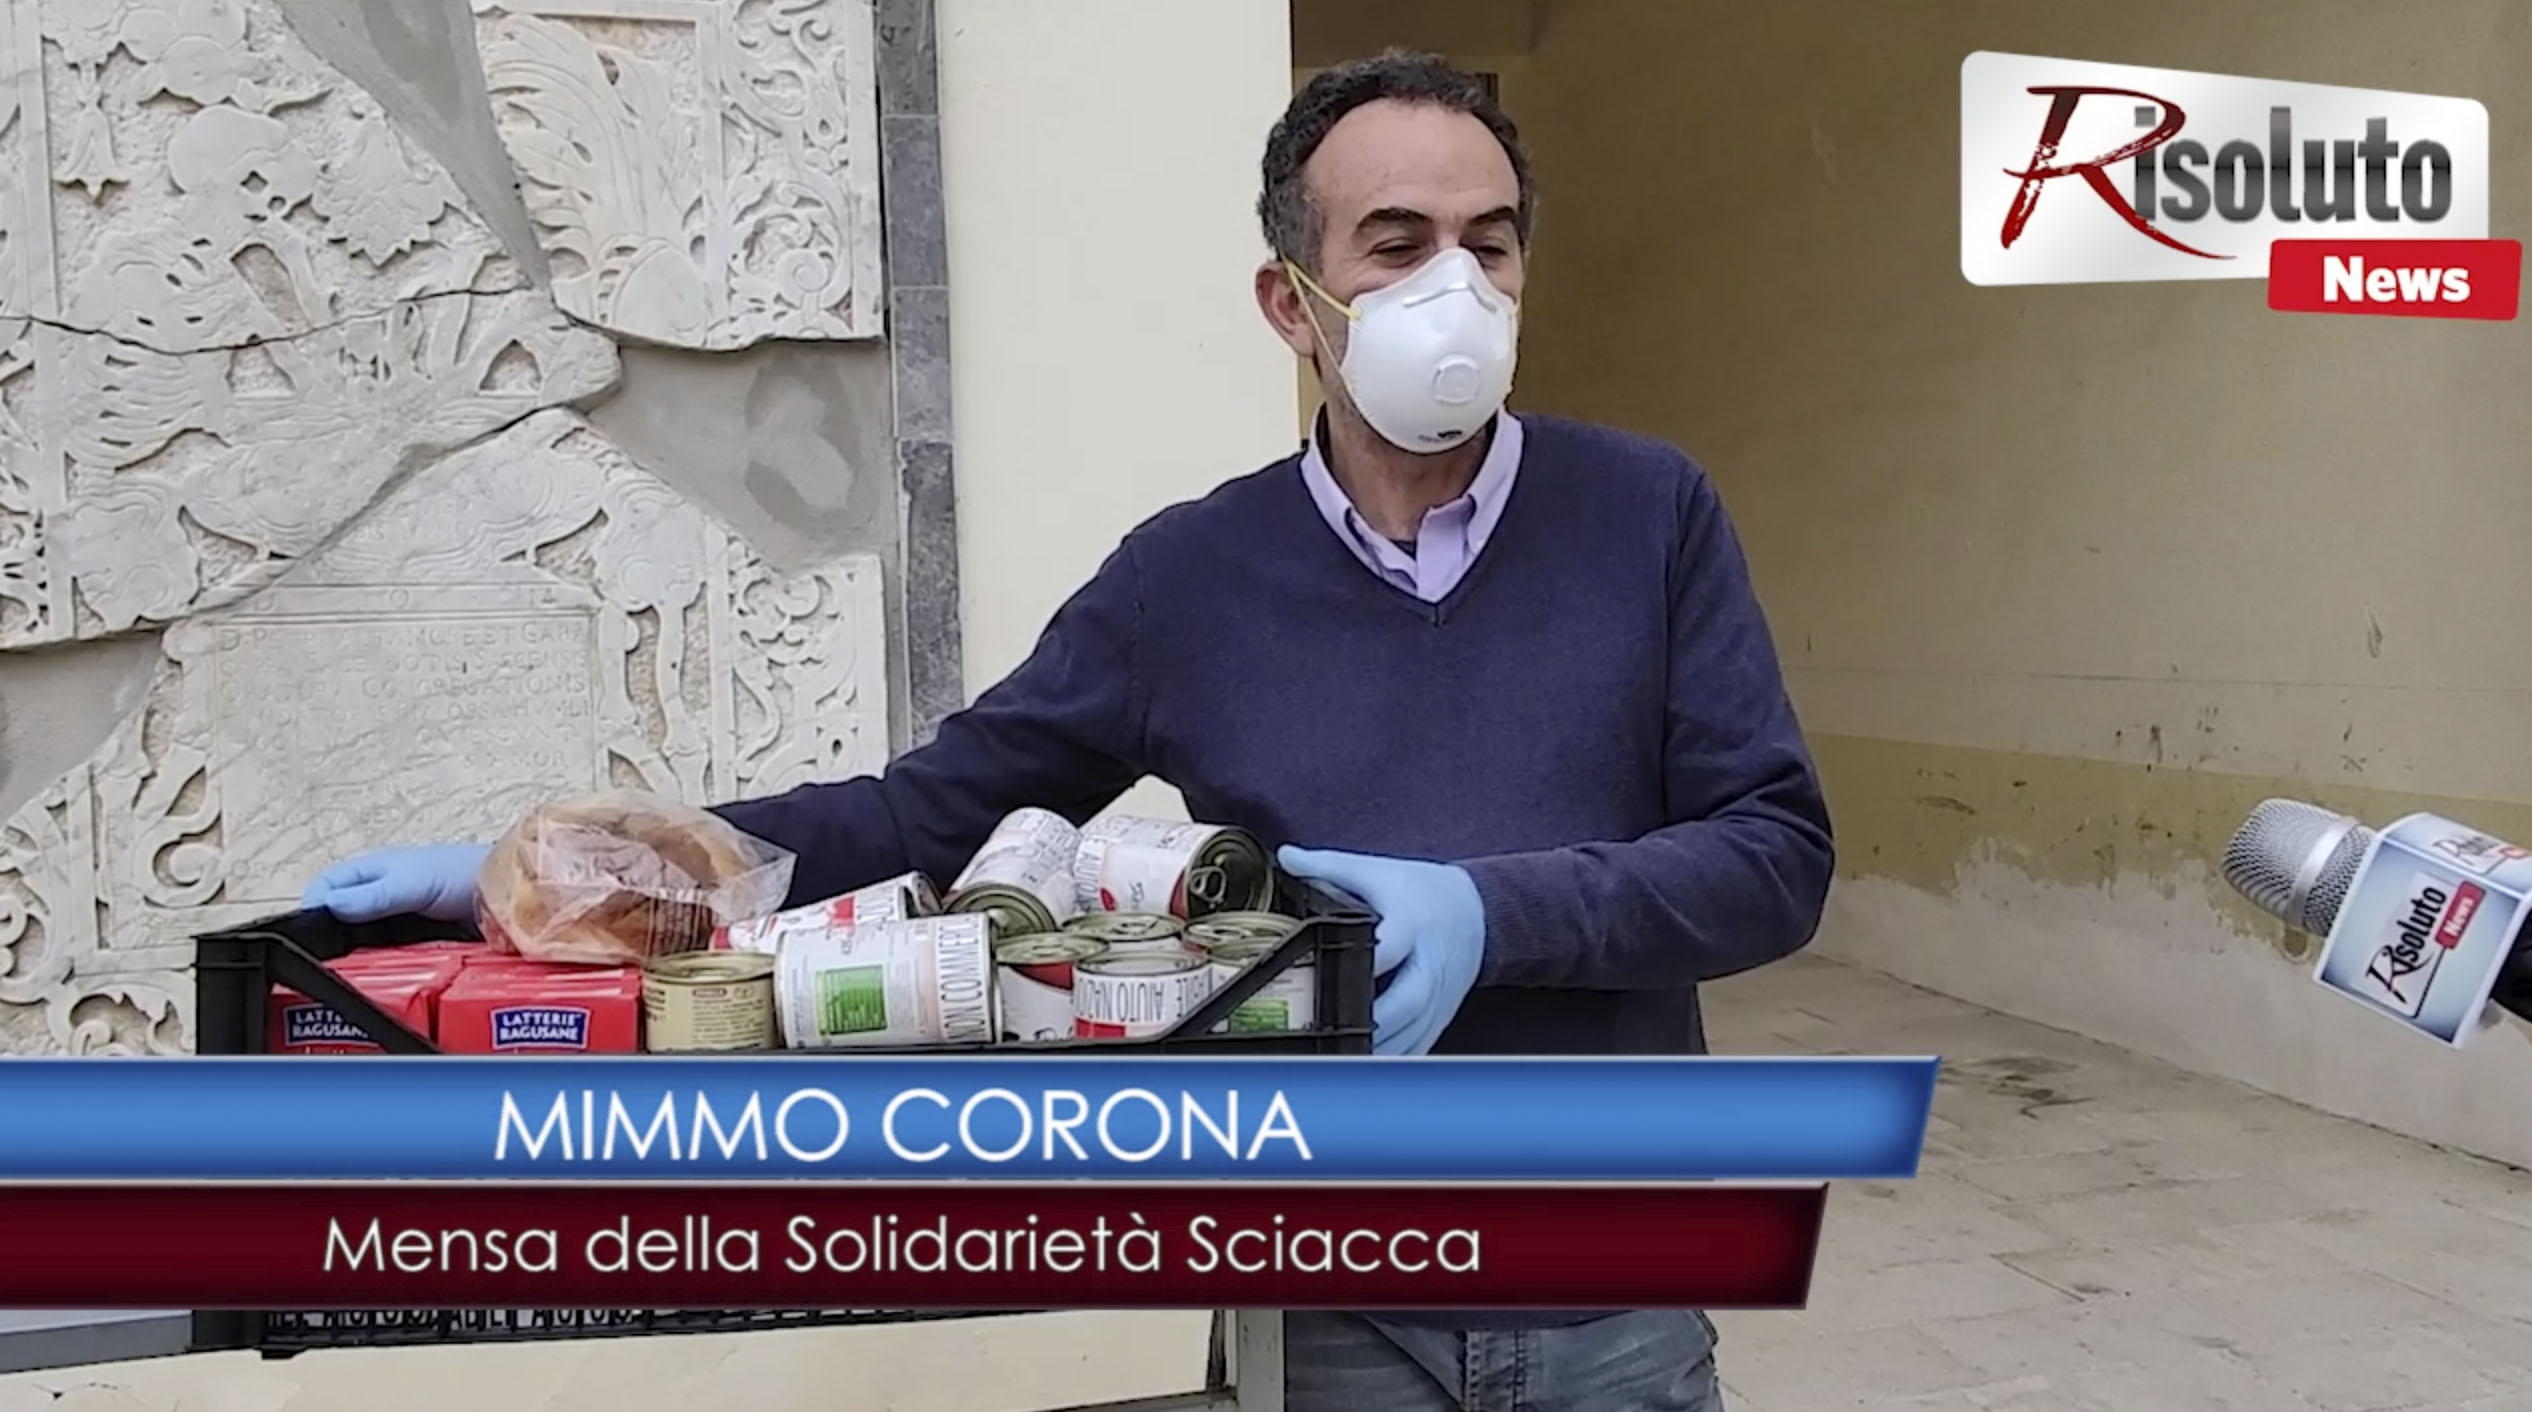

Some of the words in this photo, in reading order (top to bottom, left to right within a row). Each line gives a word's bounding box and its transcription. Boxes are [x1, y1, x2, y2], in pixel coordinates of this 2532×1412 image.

[2443, 894, 2475, 937] News
[2365, 886, 2448, 1004] Risoluto
[500, 1026, 578, 1041] RAGUSANE
[502, 1011, 577, 1027] LATTERIE
[942, 1005, 986, 1042] NON
